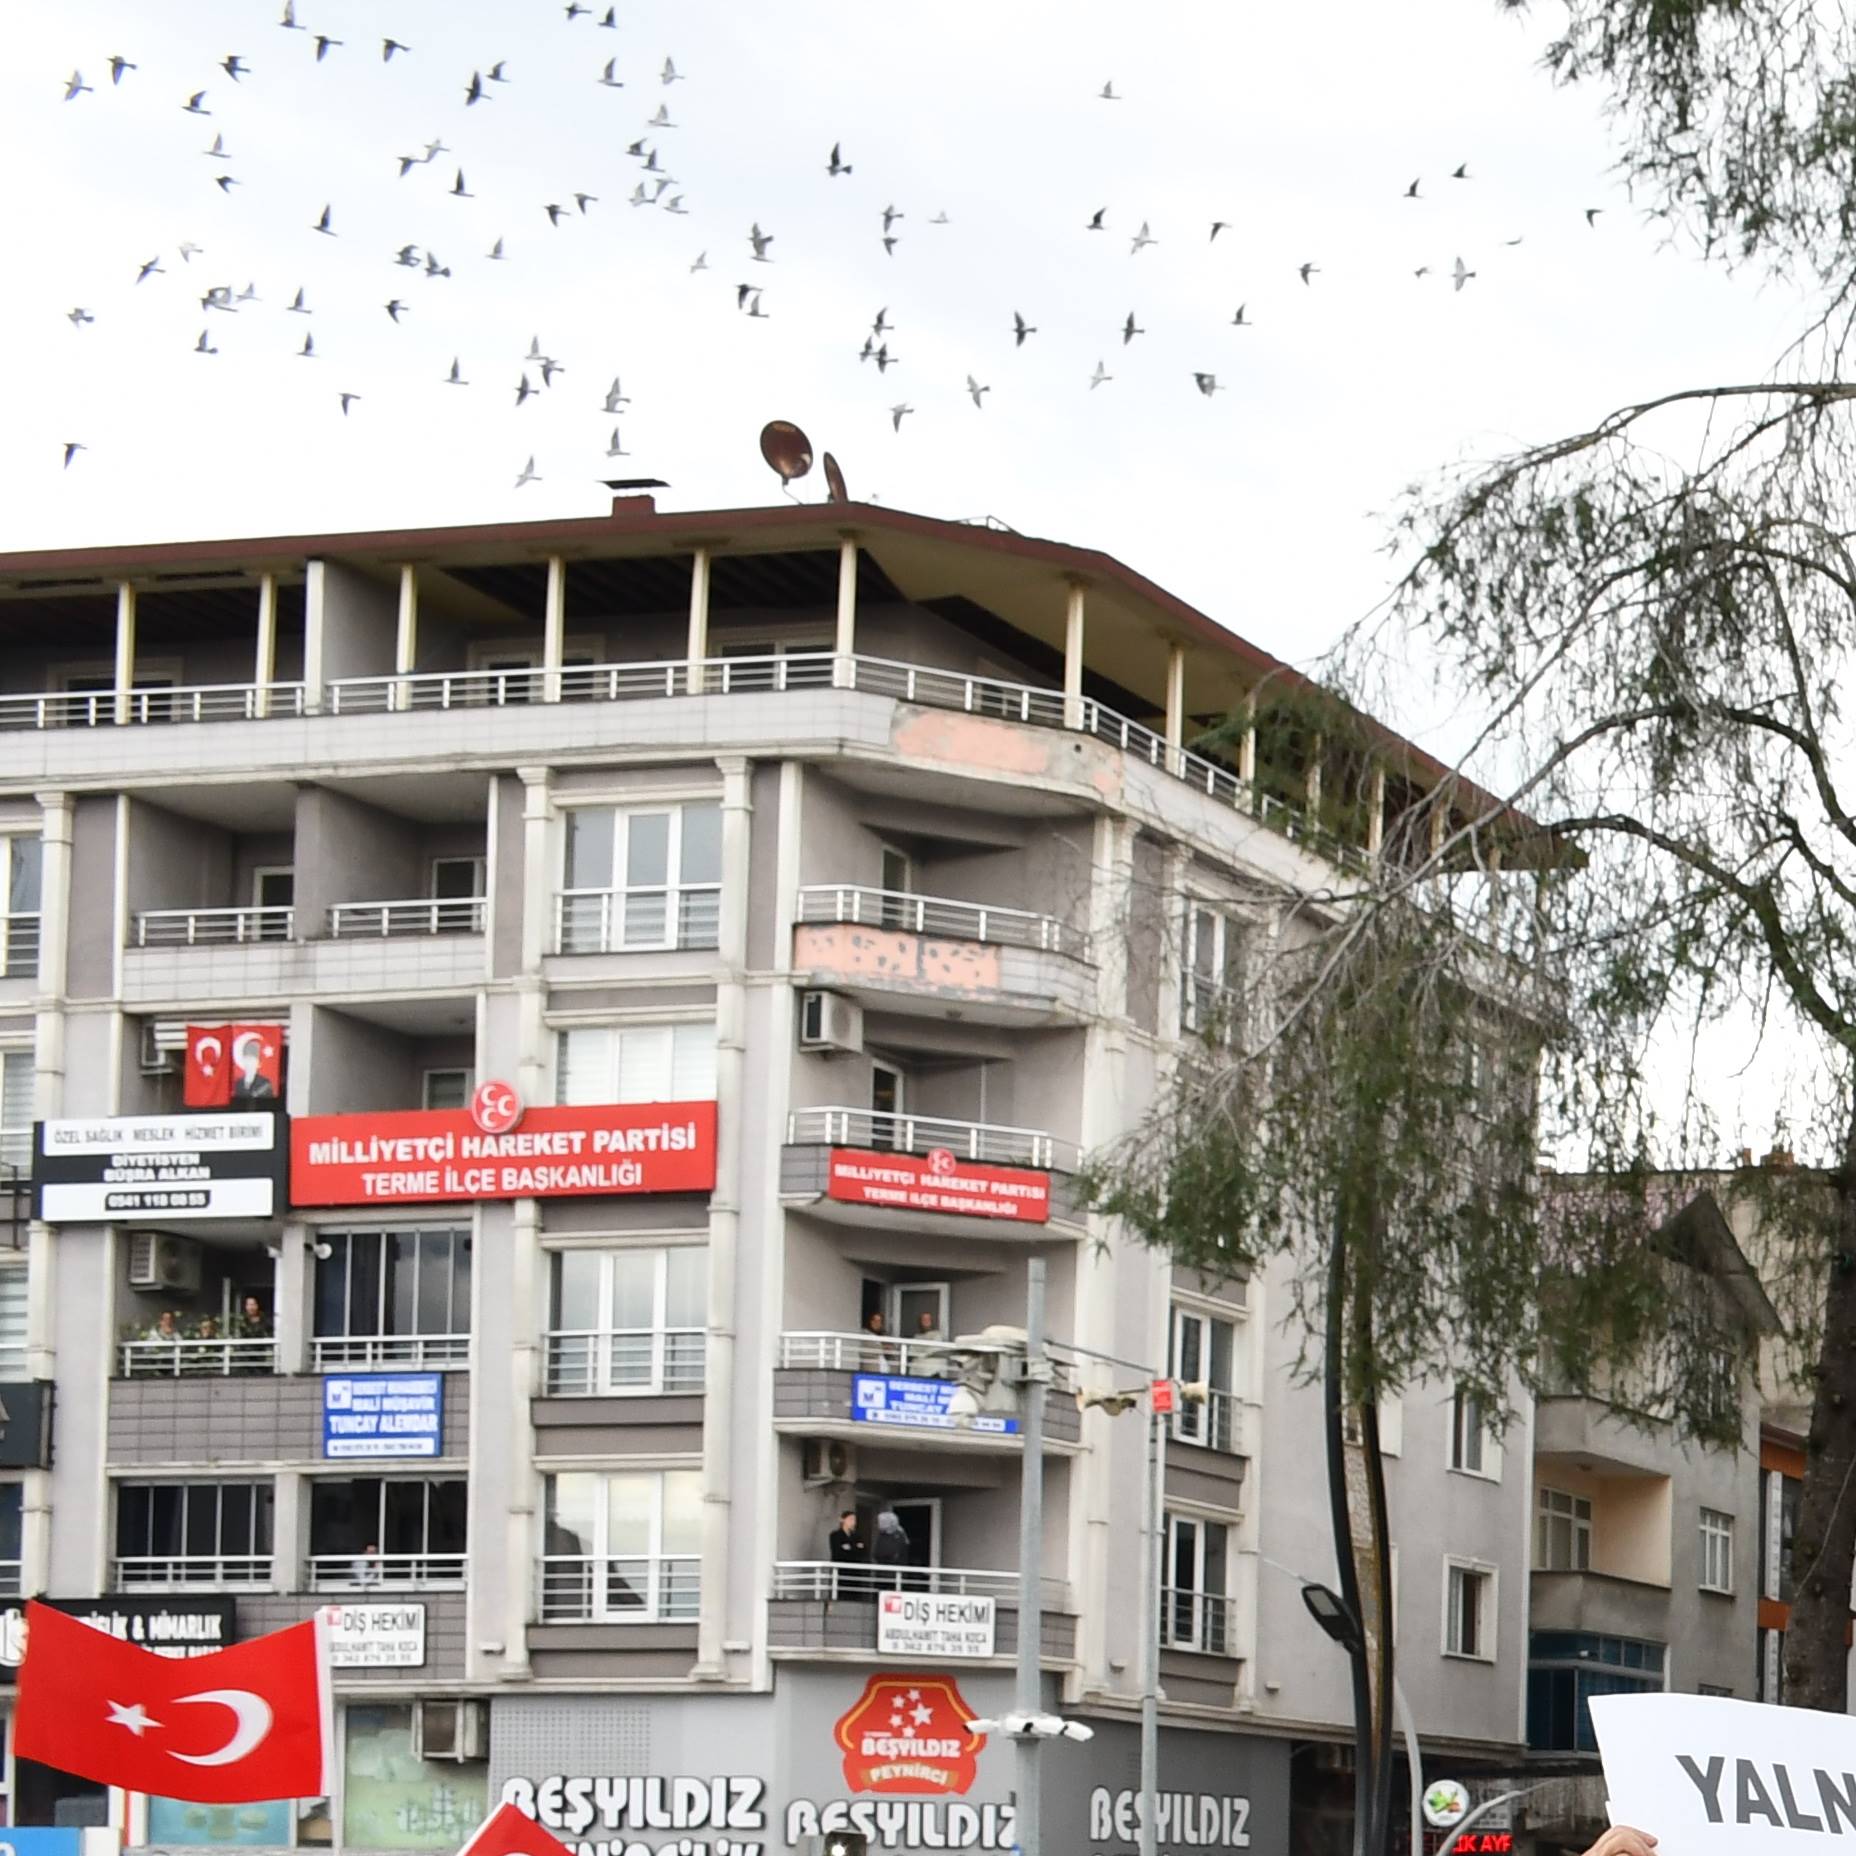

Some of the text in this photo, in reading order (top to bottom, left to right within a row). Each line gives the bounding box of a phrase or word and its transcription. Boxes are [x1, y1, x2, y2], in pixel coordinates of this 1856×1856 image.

[309, 1122, 697, 1165] MİLLİYETÇİ HAREKET PARTİSİ
[362, 1159, 642, 1196] TERME İLÇE BAŞKANLIĞI
[834, 1163, 1046, 1200] MİLLİYETÇİ HAREKET PARTİSİ
[132, 1614, 145, 1640] &
[149, 1609, 223, 1640] MİMARLIK
[344, 1607, 420, 1636] DİŞ HEKİMİ
[904, 1599, 991, 1627] DİŞ HEKİMİ
[861, 1737, 962, 1761] BEŞYILDIZ
[869, 1763, 949, 1786] PEYNİRCİ
[502, 1775, 764, 1836] BEŞYILDIZ
